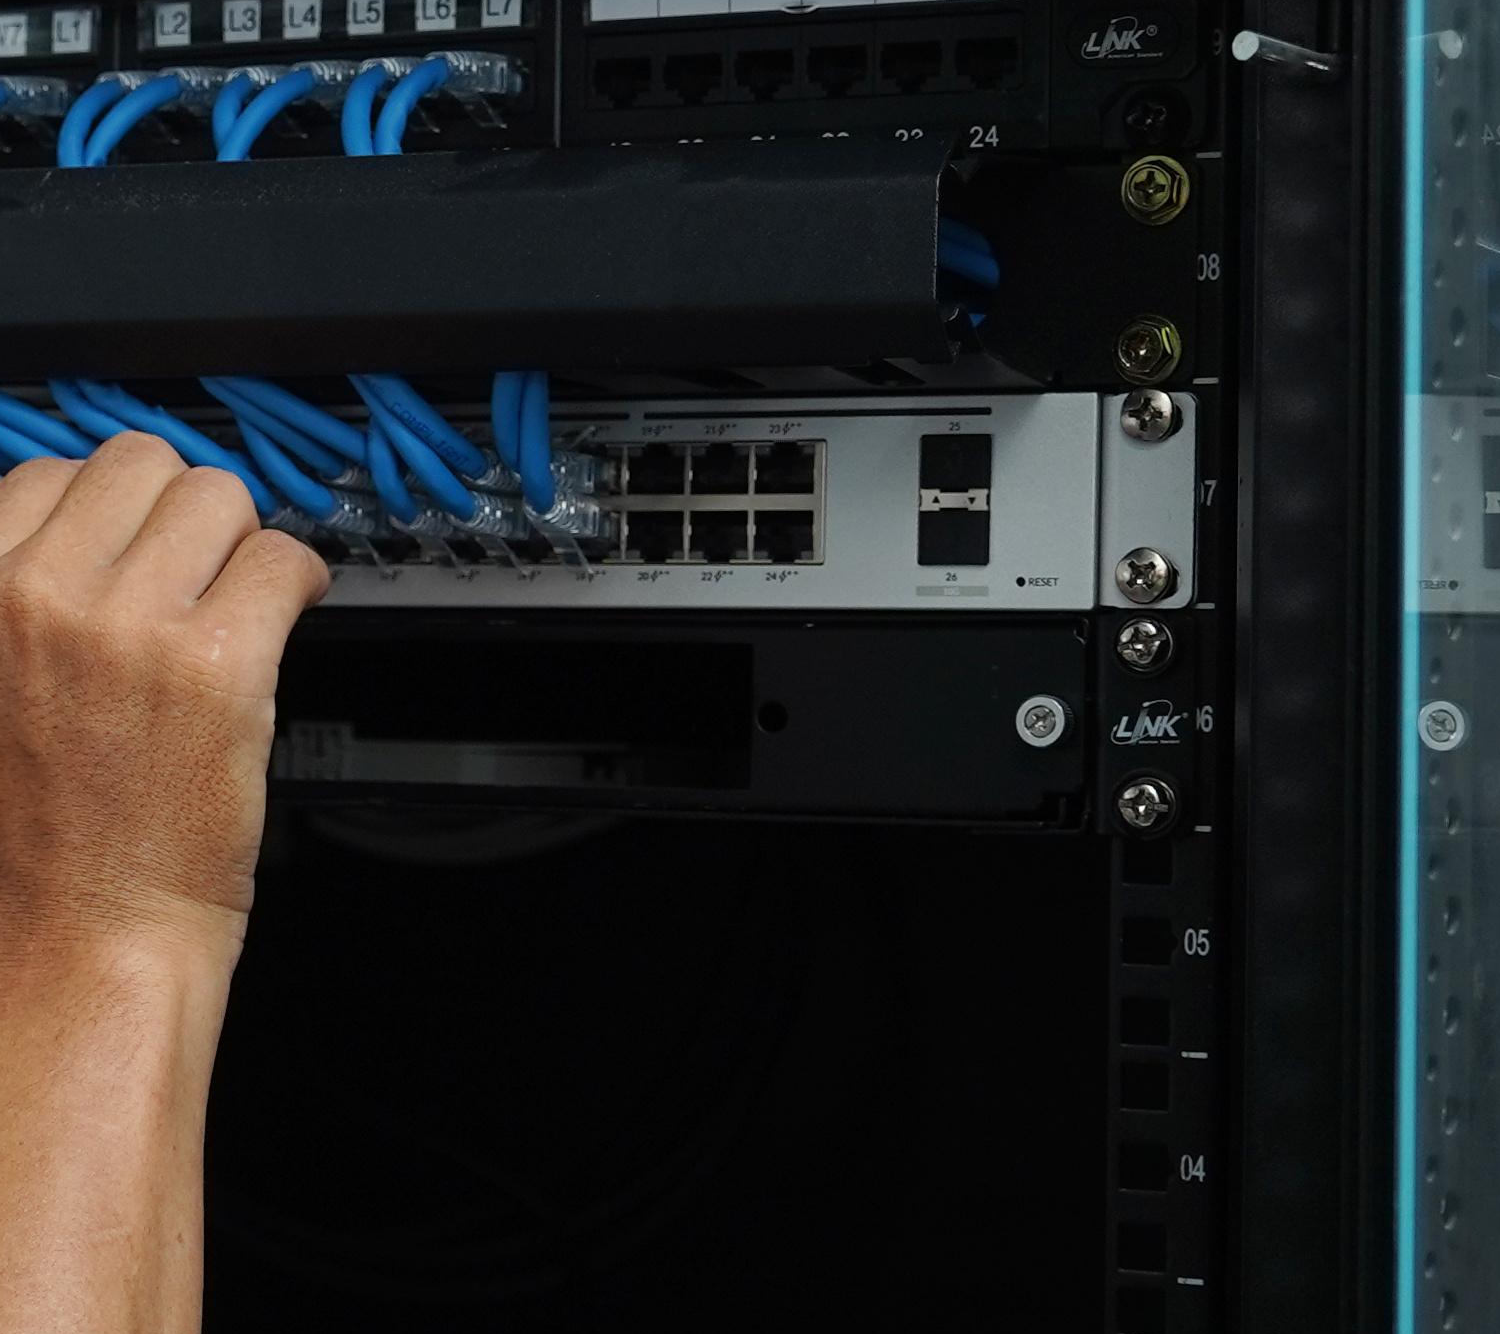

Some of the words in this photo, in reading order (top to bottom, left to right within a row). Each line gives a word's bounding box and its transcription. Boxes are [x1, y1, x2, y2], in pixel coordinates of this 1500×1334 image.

[158, 12, 189, 36] L2
[227, 7, 258, 33] L3
[288, 3, 318, 29] L4
[56, 19, 82, 44] L1
[1082, 18, 1146, 57] LINK
[968, 124, 999, 149] 24
[1197, 253, 1220, 281] 08
[945, 572, 958, 582] 26
[1028, 577, 1060, 587] RESET
[1112, 703, 1181, 743] LINK
[1183, 928, 1210, 957] 05
[1179, 1154, 1206, 1183] 04
